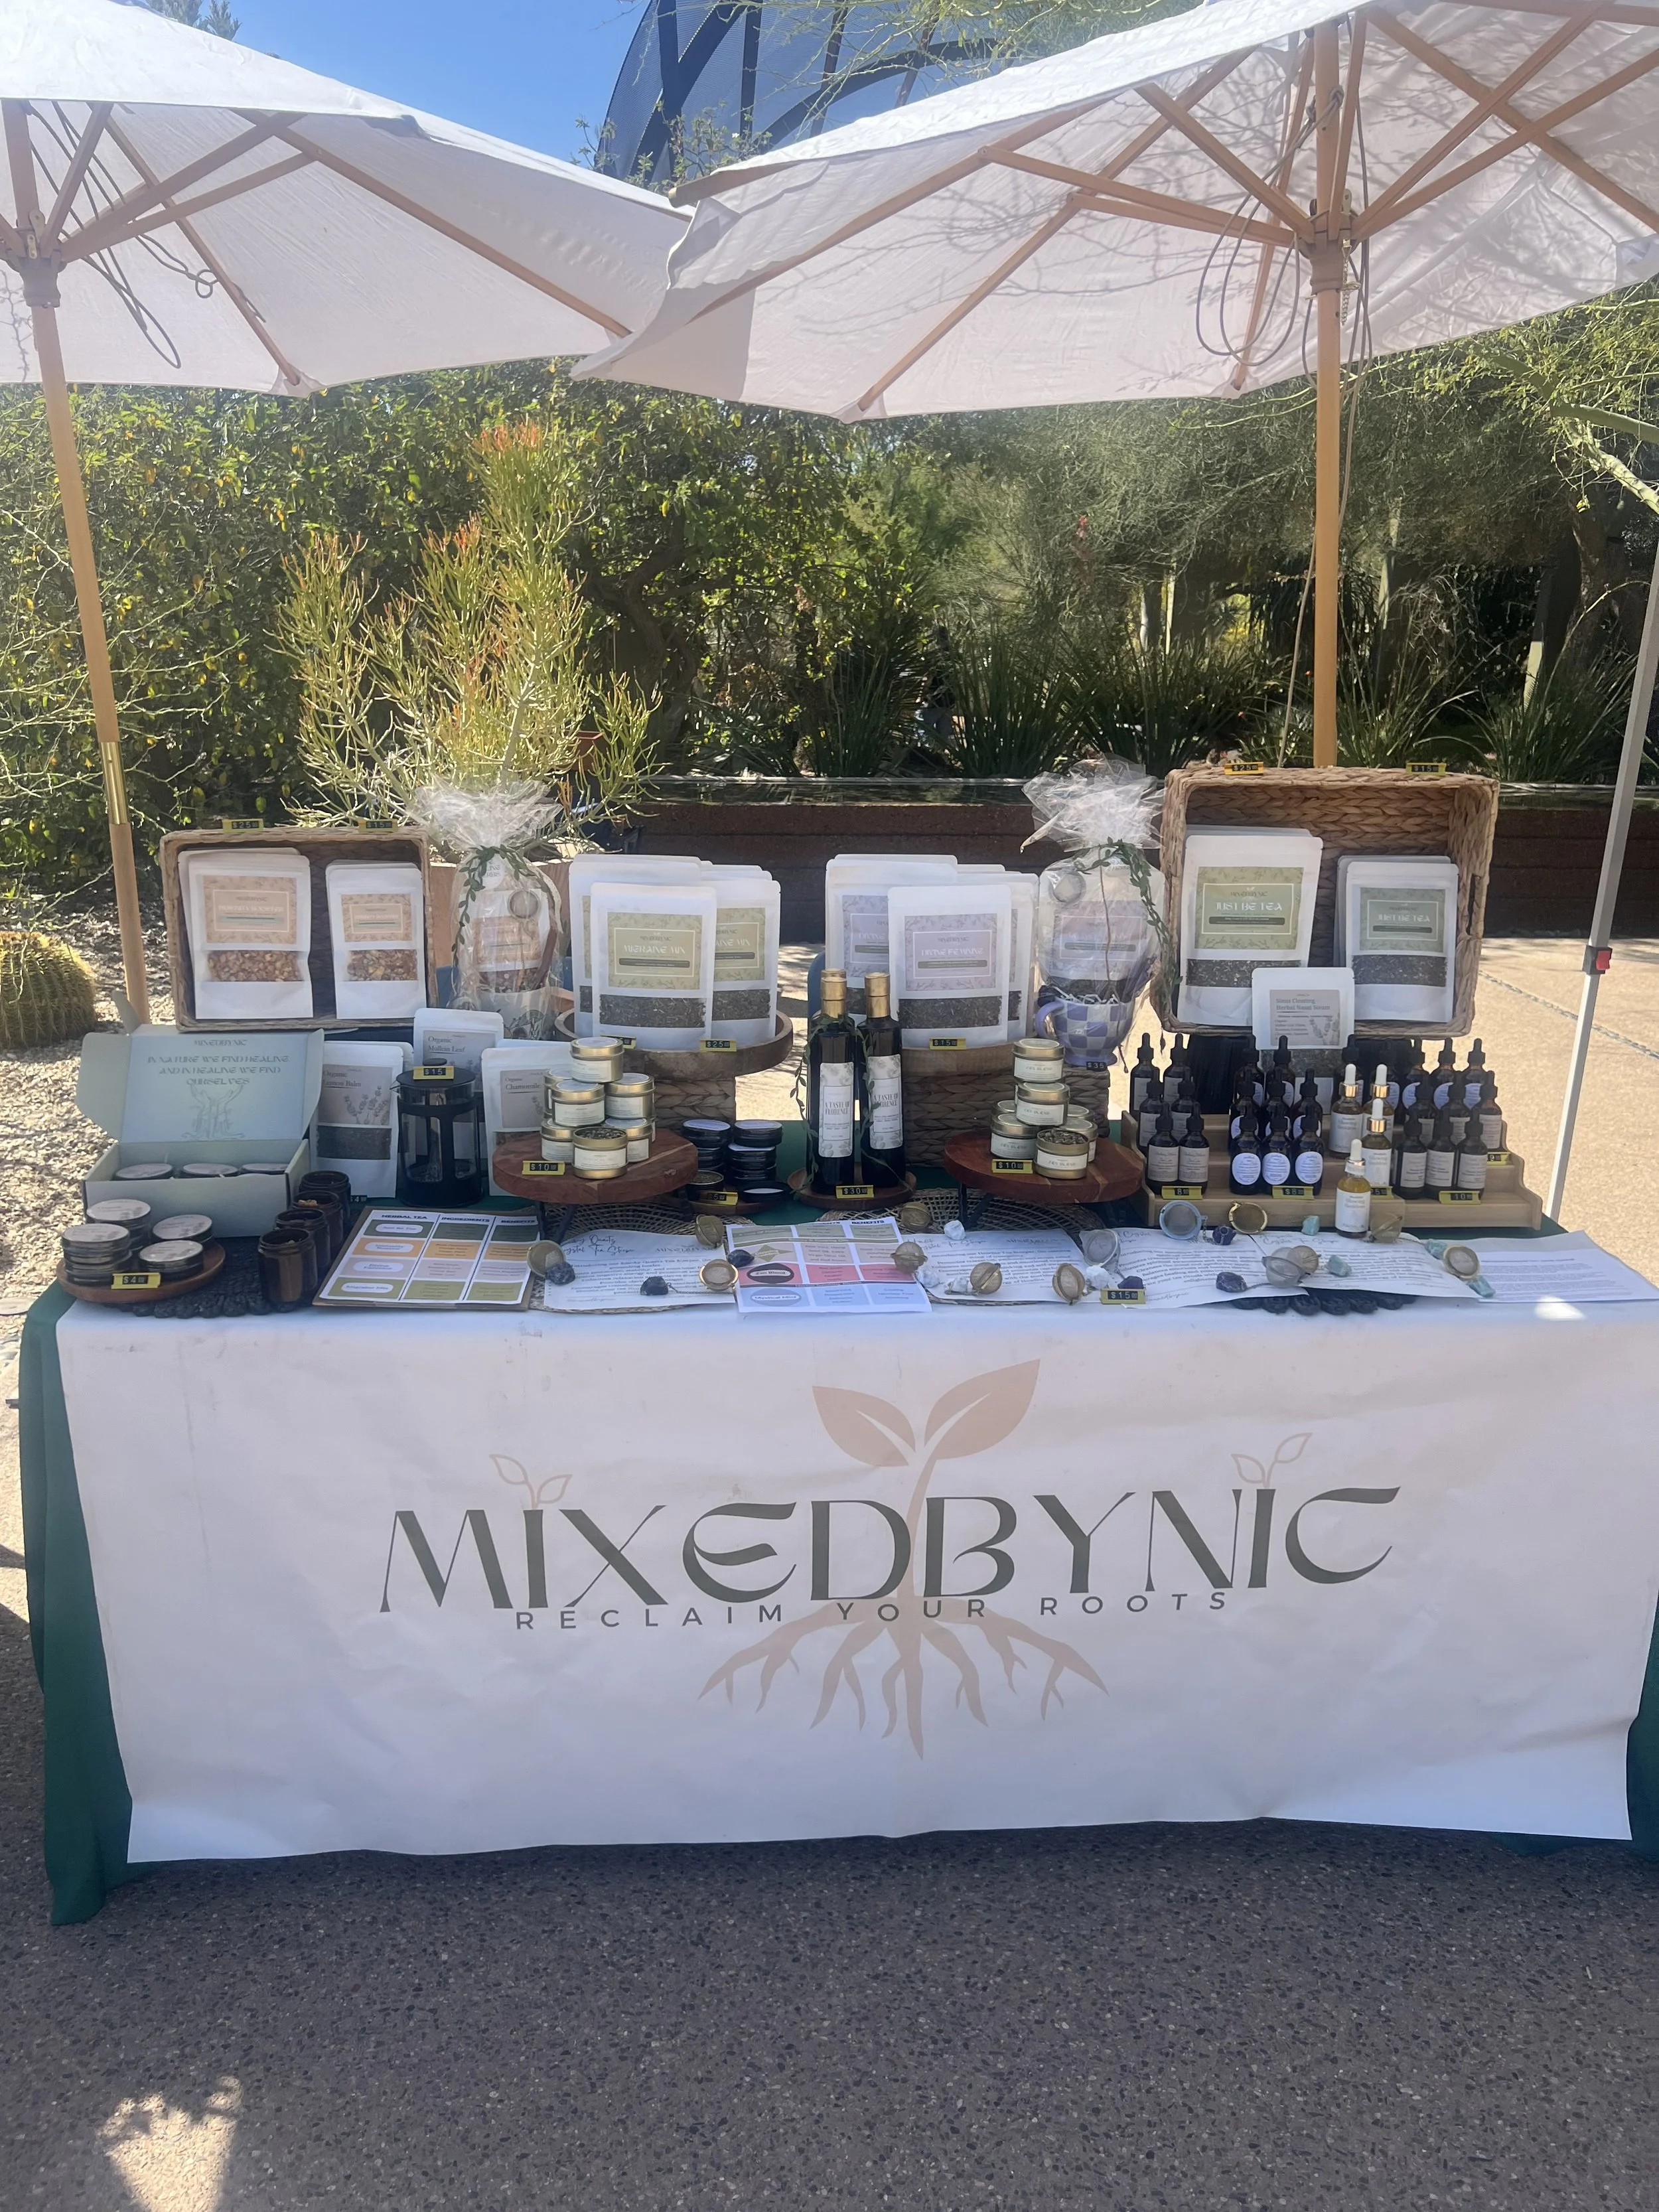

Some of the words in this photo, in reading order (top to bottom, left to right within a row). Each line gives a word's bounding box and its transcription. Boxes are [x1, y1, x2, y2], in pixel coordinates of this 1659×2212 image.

[1216, 902, 1238, 911] JUST
[624, 944, 668, 954] MIGRAINE
[670, 946, 686, 954] MIX
[379, 1486, 1402, 1613] MIXEDBYNIC
[516, 1604, 782, 1630] RECLAIM
[835, 1599, 985, 1623] YOUR
[1039, 1591, 1226, 1616] ROOTS
